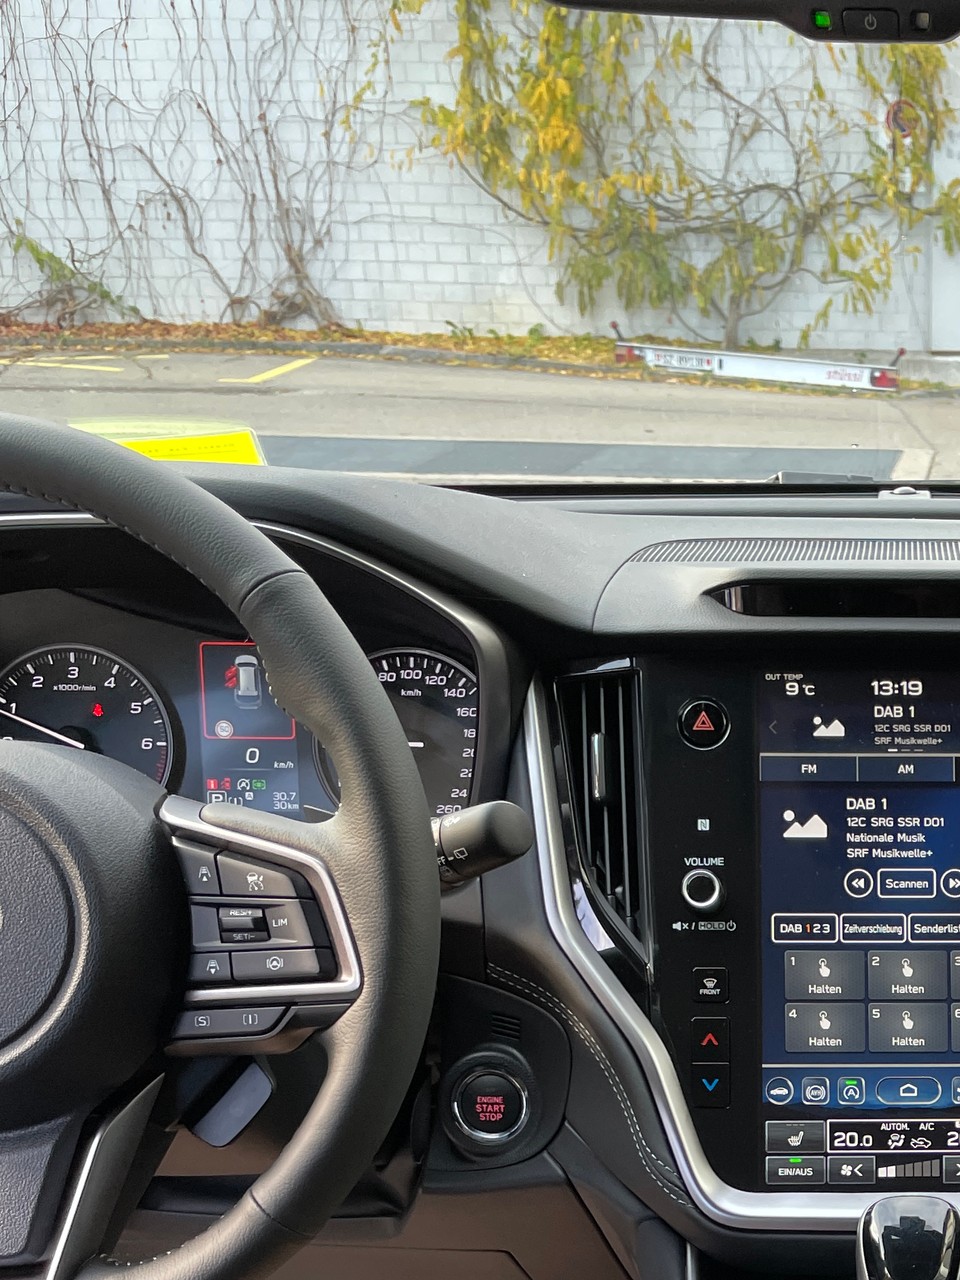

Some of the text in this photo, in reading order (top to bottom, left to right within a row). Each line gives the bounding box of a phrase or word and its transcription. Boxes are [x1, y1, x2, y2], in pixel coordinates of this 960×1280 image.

[68, 667, 79, 679] 3
[400, 669, 422, 679] 100
[765, 673, 804, 681] OUT TEMP
[32, 676, 44, 688] 2
[104, 677, 116, 688] 4
[425, 675, 446, 685] 120
[401, 689, 422, 697] km/h
[443, 688, 466, 697] 140
[871, 681, 923, 696] 13:19
[9, 703, 17, 714] 1
[130, 702, 142, 714] 5
[874, 706, 915, 718] DAB 1
[892, 725, 911, 733] SRG
[914, 725, 932, 733] SSR
[141, 738, 153, 750] 6
[874, 737, 943, 745] SRF Musikwelle+
[245, 748, 260, 763] 0
[274, 761, 294, 769] km/h
[801, 764, 817, 774] FM
[898, 765, 914, 774] AM
[273, 792, 296, 801] 30.7
[846, 798, 888, 810] DAB 1
[436, 805, 461, 814] 260
[846, 818, 866, 827] 12C
[871, 818, 894, 827] SRG
[897, 818, 920, 827] SSR
[846, 833, 926, 842] Nationale Musik
[846, 848, 933, 858] SRF Musikwelle+
[684, 857, 725, 866] VOLUME
[885, 879, 929, 889] Scannen
[272, 919, 288, 927] LIM
[780, 924, 803, 933] DAB
[844, 924, 903, 935] Zeitverschiebung
[790, 956, 796, 966] 1
[871, 956, 880, 966] 2
[699, 988, 721, 996] FRONT
[808, 984, 842, 994] Halten
[891, 984, 925, 994] Halten
[788, 1009, 798, 1018] 4
[872, 1009, 881, 1018] 5
[809, 1036, 842, 1046] Halten
[892, 1036, 925, 1046] Halten
[475, 1104, 505, 1112] START
[480, 1113, 503, 1121] STOP
[880, 1123, 935, 1131] AUTOM. A/C
[833, 1132, 873, 1147] 20.0
[778, 1168, 814, 1176] EIN/AUS
